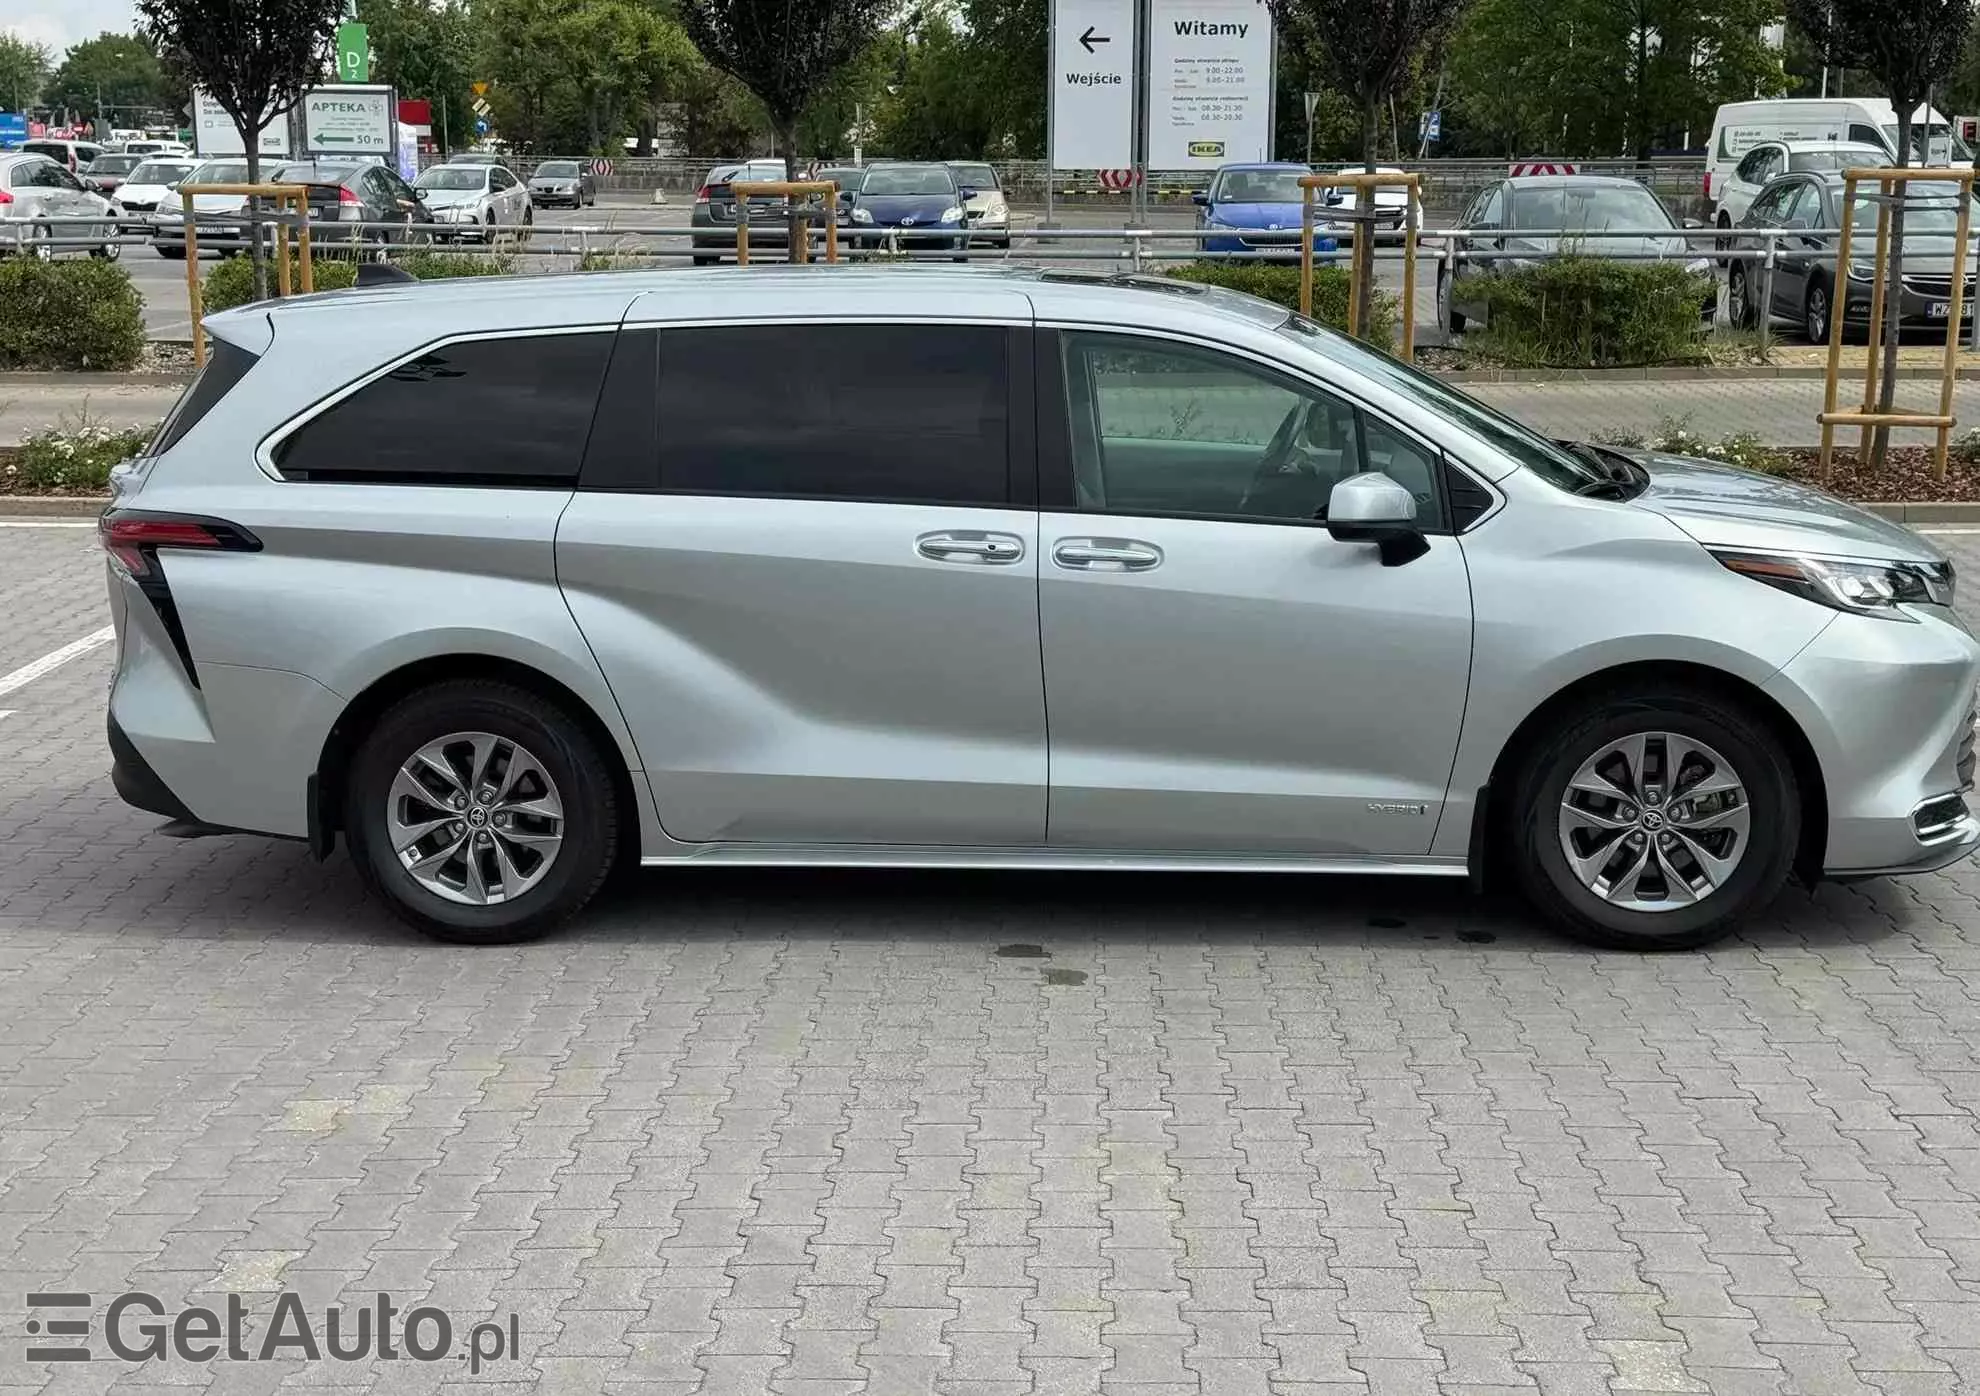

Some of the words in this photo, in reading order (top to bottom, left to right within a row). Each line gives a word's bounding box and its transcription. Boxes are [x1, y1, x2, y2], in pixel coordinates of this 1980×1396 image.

[1174, 20, 1249, 39] Witamy
[346, 51, 360, 68] D
[351, 69, 358, 79] 2
[1066, 72, 1122, 87] Wejście
[312, 102, 366, 113] APTEKA
[357, 135, 371, 144] 50
[1191, 145, 1222, 153] IKEA
